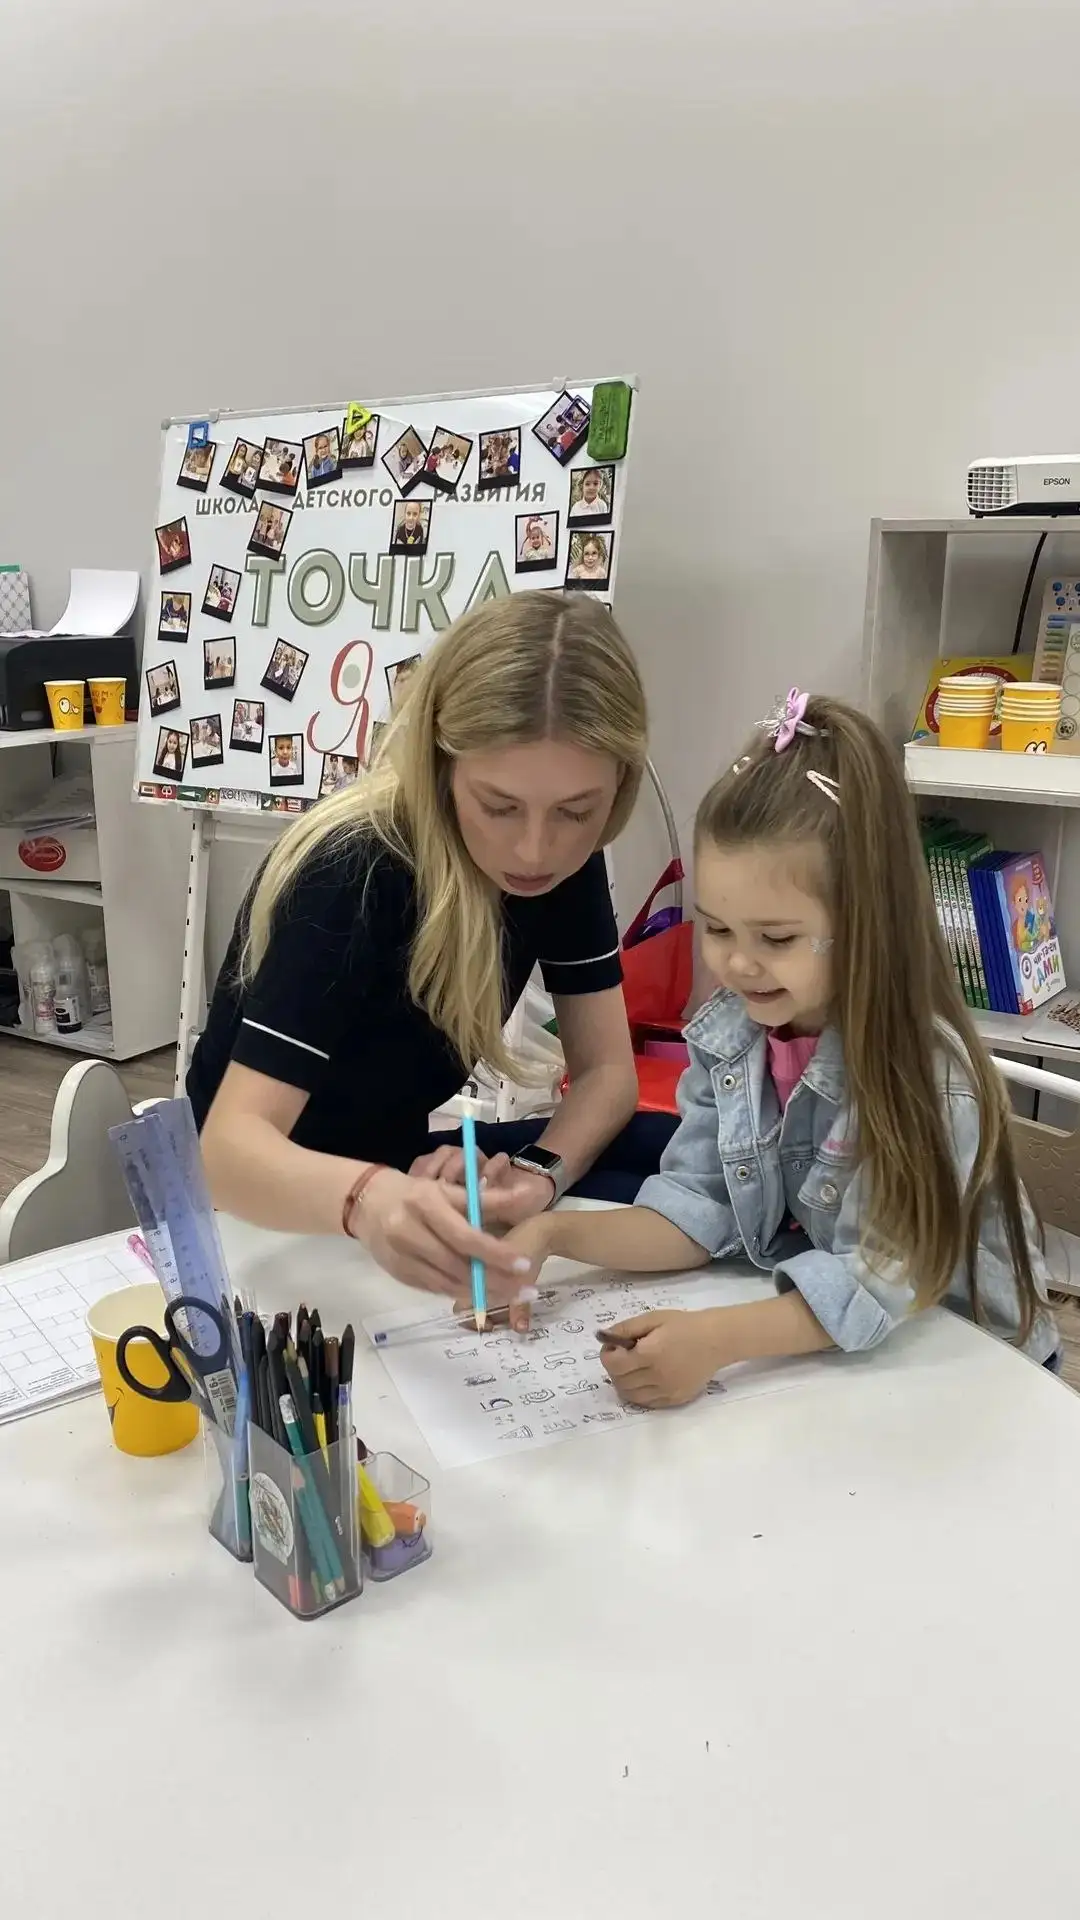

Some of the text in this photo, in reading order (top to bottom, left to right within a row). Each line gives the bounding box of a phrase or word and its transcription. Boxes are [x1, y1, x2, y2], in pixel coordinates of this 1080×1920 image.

[1043, 477, 1071, 486] EPSON
[195, 495, 259, 516] ШКОЛА
[291, 487, 394, 510] ДЕТСКОГО
[244, 547, 512, 633] ТОЧКА
[1032, 954, 1060, 994] САМИ
